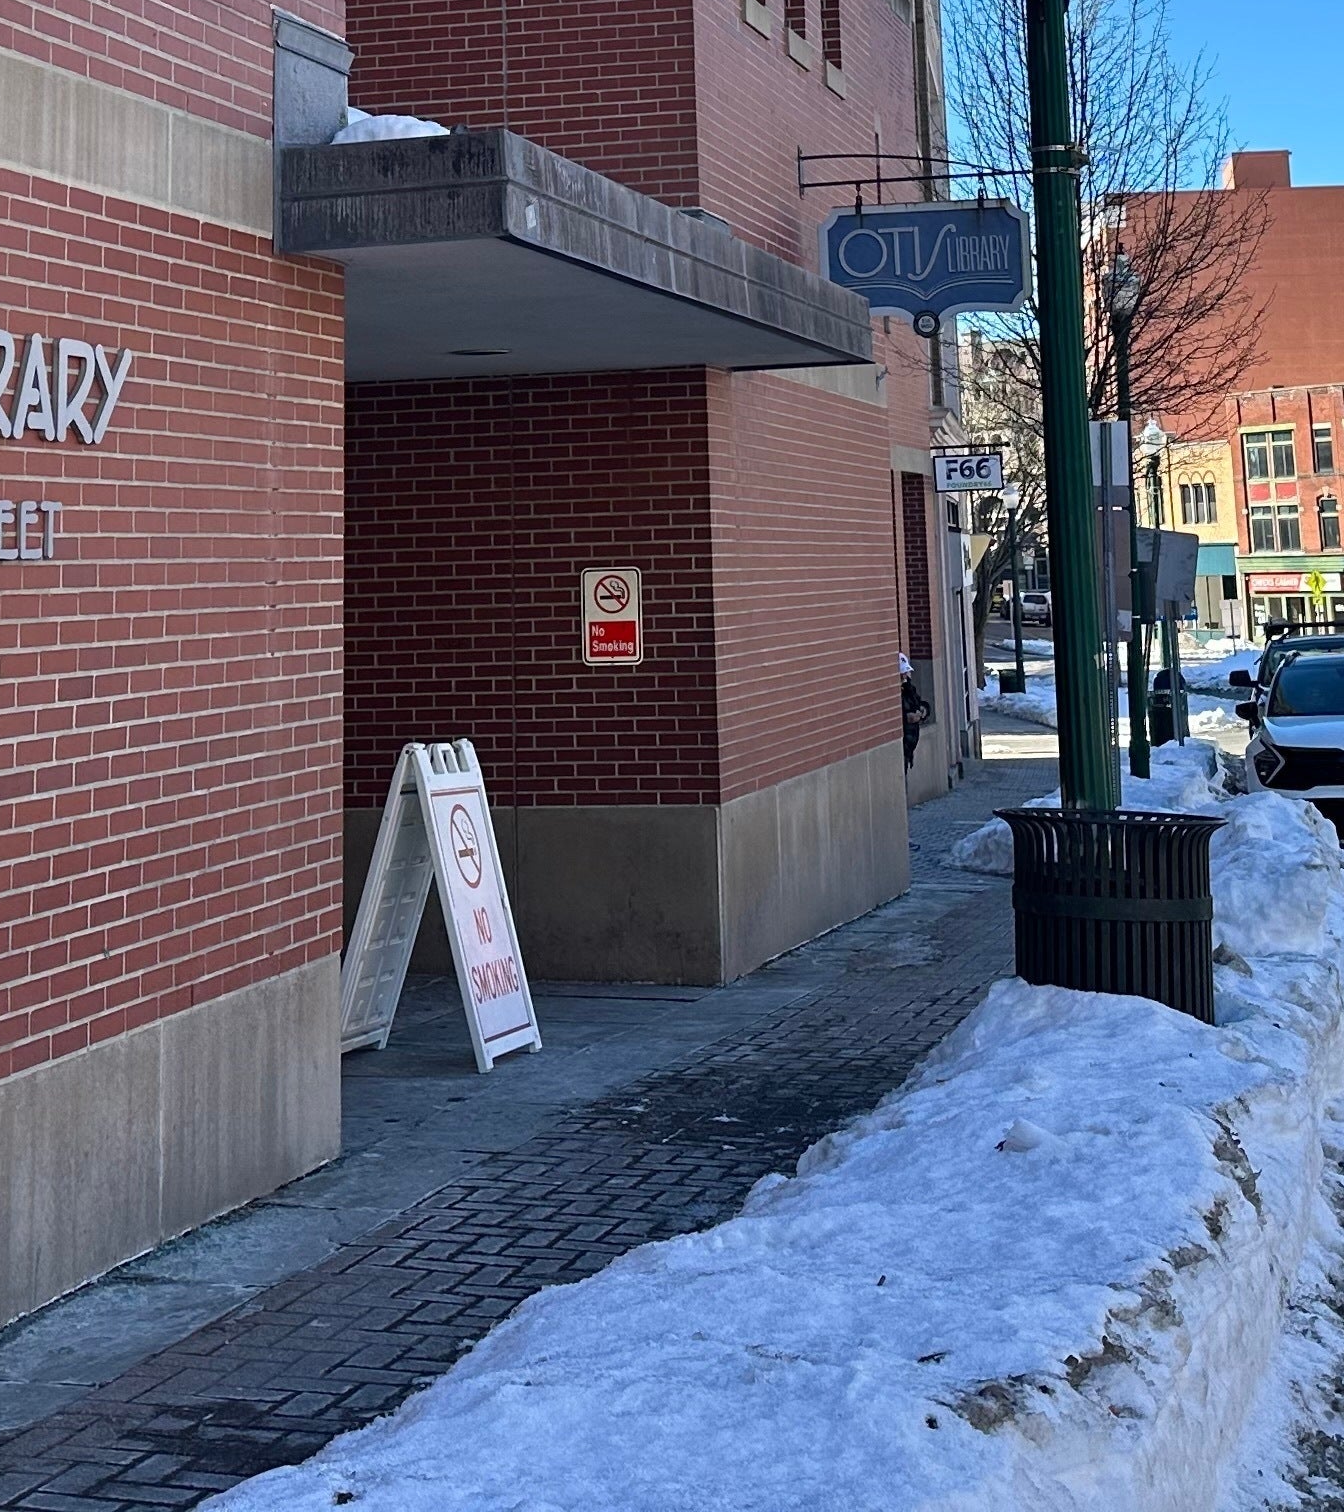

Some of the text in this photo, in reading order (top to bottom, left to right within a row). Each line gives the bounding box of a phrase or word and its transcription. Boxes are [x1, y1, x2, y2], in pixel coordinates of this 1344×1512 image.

[839, 223, 1009, 281] OTIS LIBRARY
[946, 458, 992, 480] F66
[591, 624, 605, 637] No
[592, 640, 634, 654] Smoking
[472, 906, 492, 945] NO
[471, 956, 519, 1004] SMOKING
